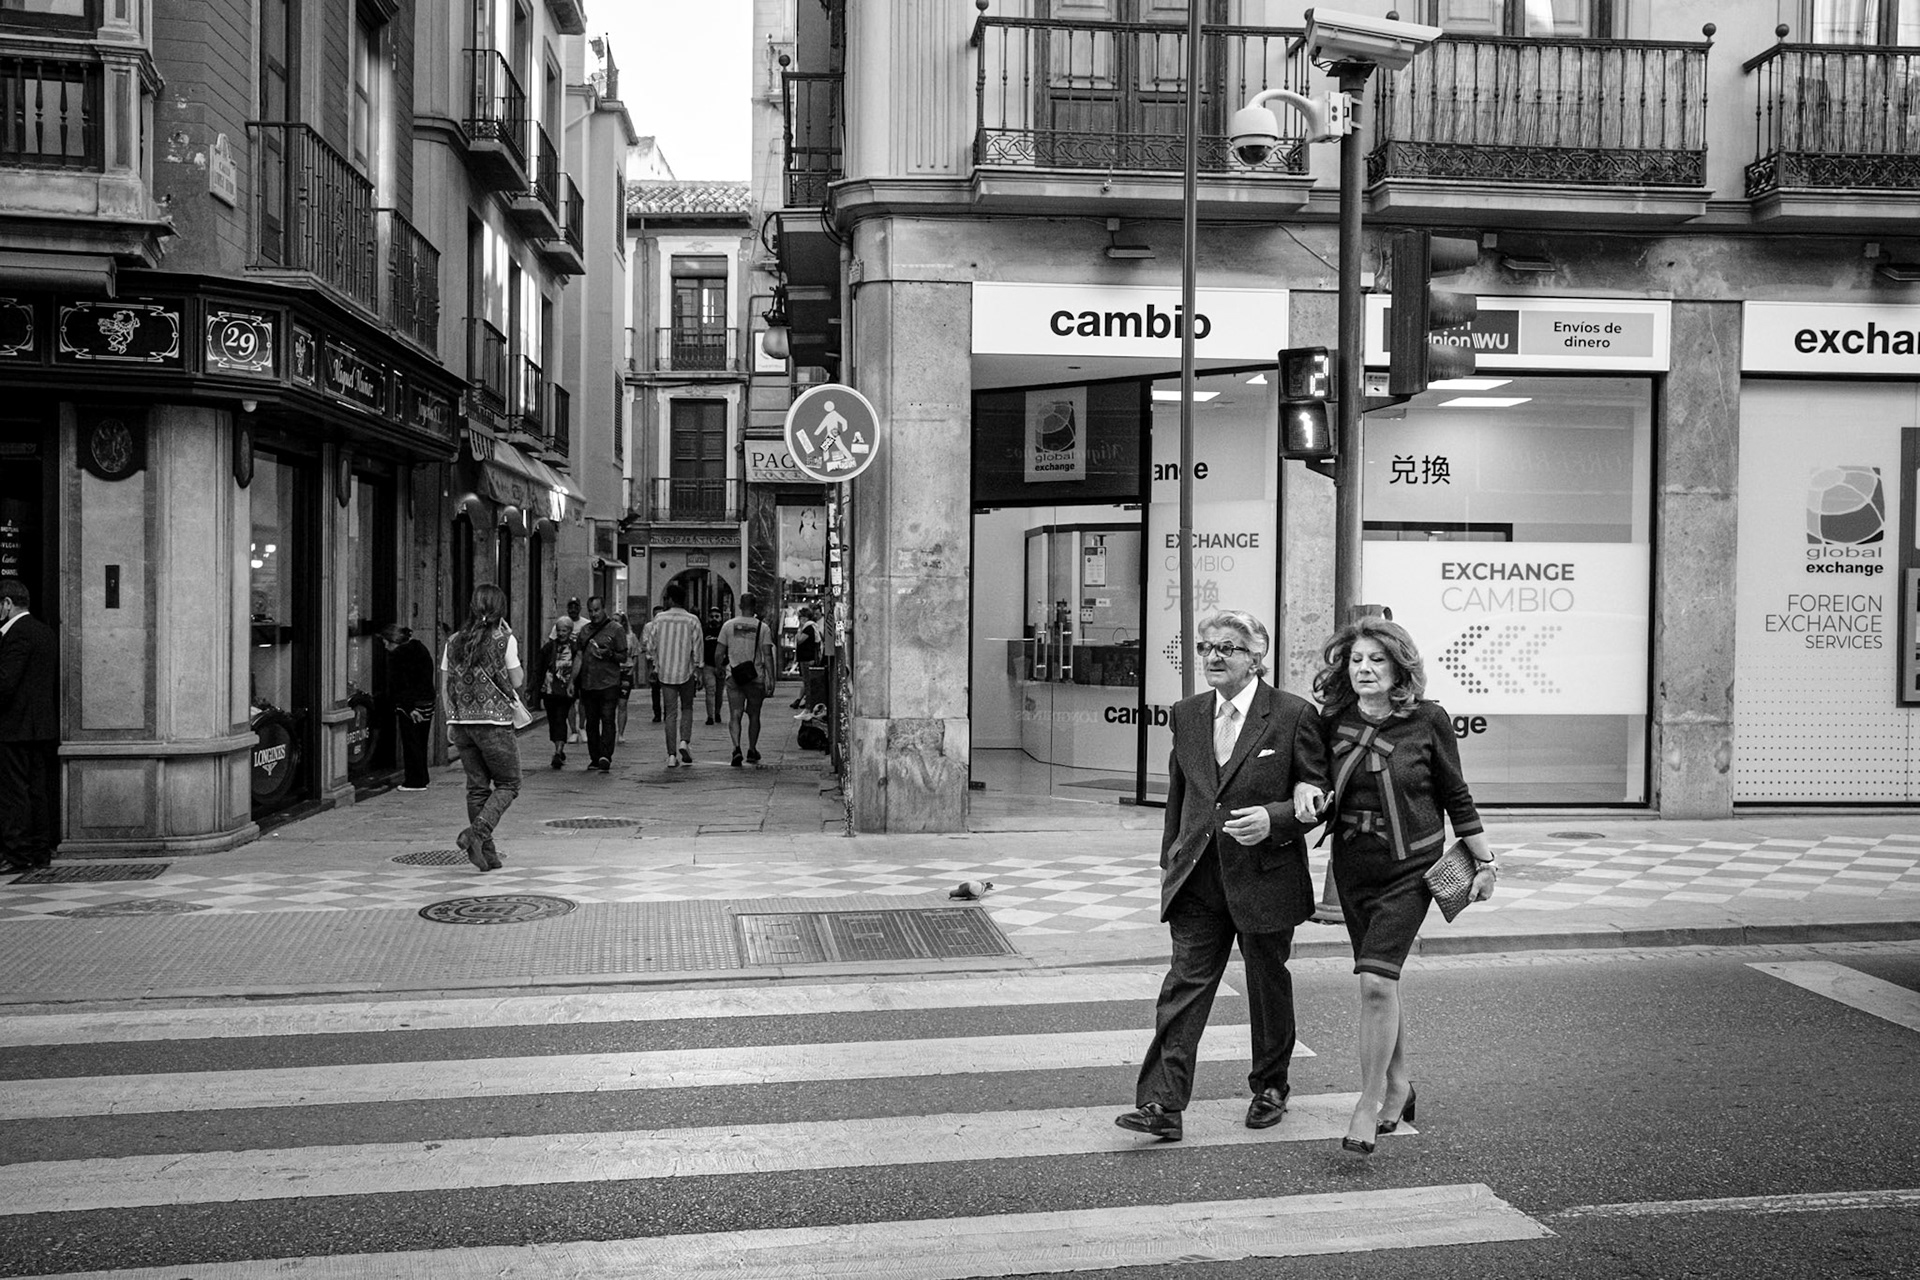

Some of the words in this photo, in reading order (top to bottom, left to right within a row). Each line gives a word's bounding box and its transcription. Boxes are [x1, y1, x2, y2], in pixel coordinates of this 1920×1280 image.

[1050, 303, 1212, 340] cambio
[1553, 319, 1601, 334] Envíos
[1604, 321, 1622, 334] de
[225, 327, 256, 356] 29
[1564, 335, 1610, 348] dinero
[1794, 321, 1920, 355] excha
[332, 355, 356, 394] Miguel
[1035, 451, 1075, 464] global
[1035, 462, 1075, 473] exchange
[1806, 546, 1882, 561] global
[1441, 562, 1575, 581] EXCHANGE
[1806, 561, 1884, 577] exchange
[1441, 586, 1575, 613] CAMBIO
[1788, 594, 1882, 613] FOREIGN
[1765, 614, 1883, 633] EXCHANGE
[1805, 635, 1883, 650] SERVICES
[1104, 704, 1173, 728] camb
[254, 744, 286, 767] LONGINES
